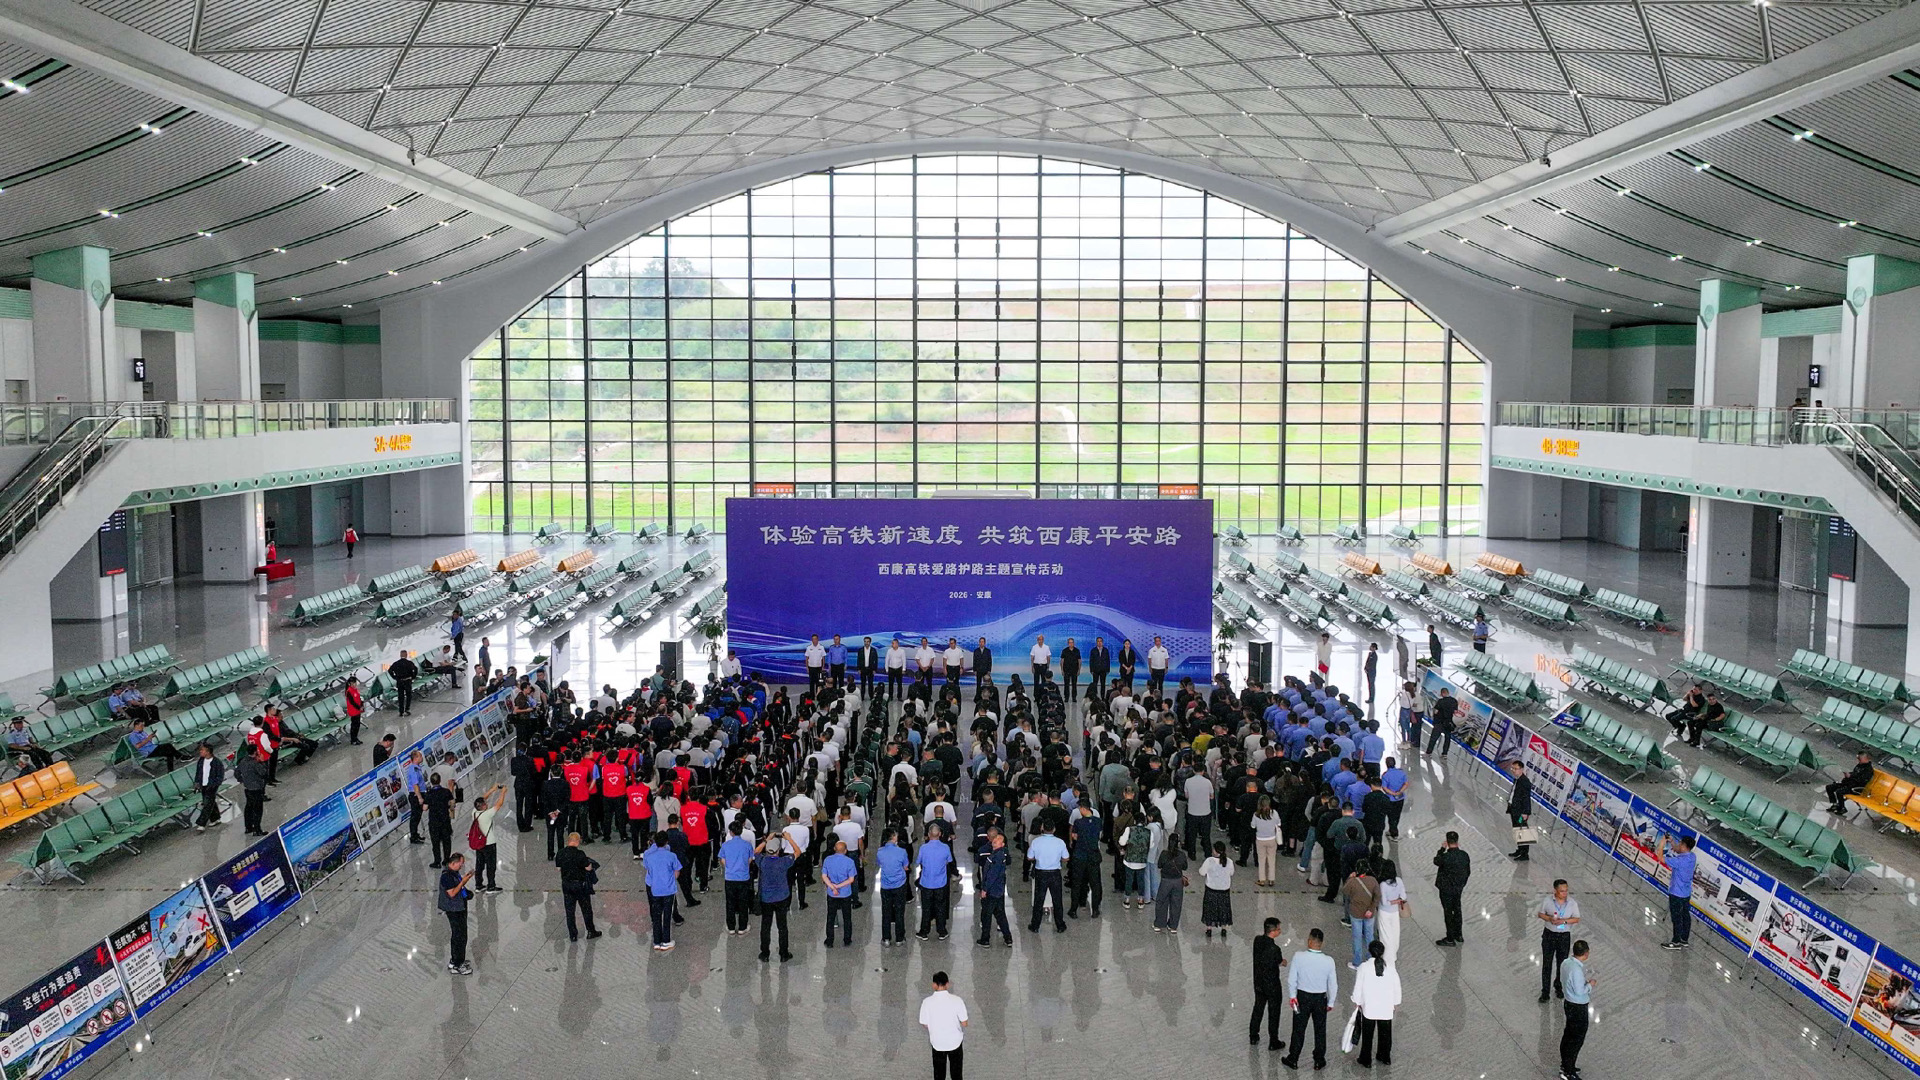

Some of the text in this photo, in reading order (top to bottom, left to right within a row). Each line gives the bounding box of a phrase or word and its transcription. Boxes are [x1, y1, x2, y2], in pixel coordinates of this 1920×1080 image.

[760, 525, 1182, 546] 体验高铁新速度 共筑西康平安路
[878, 563, 1063, 576] 西康高铁爱路护路主题宣传活动
[22, 965, 82, 1011] 这些行为要追责
